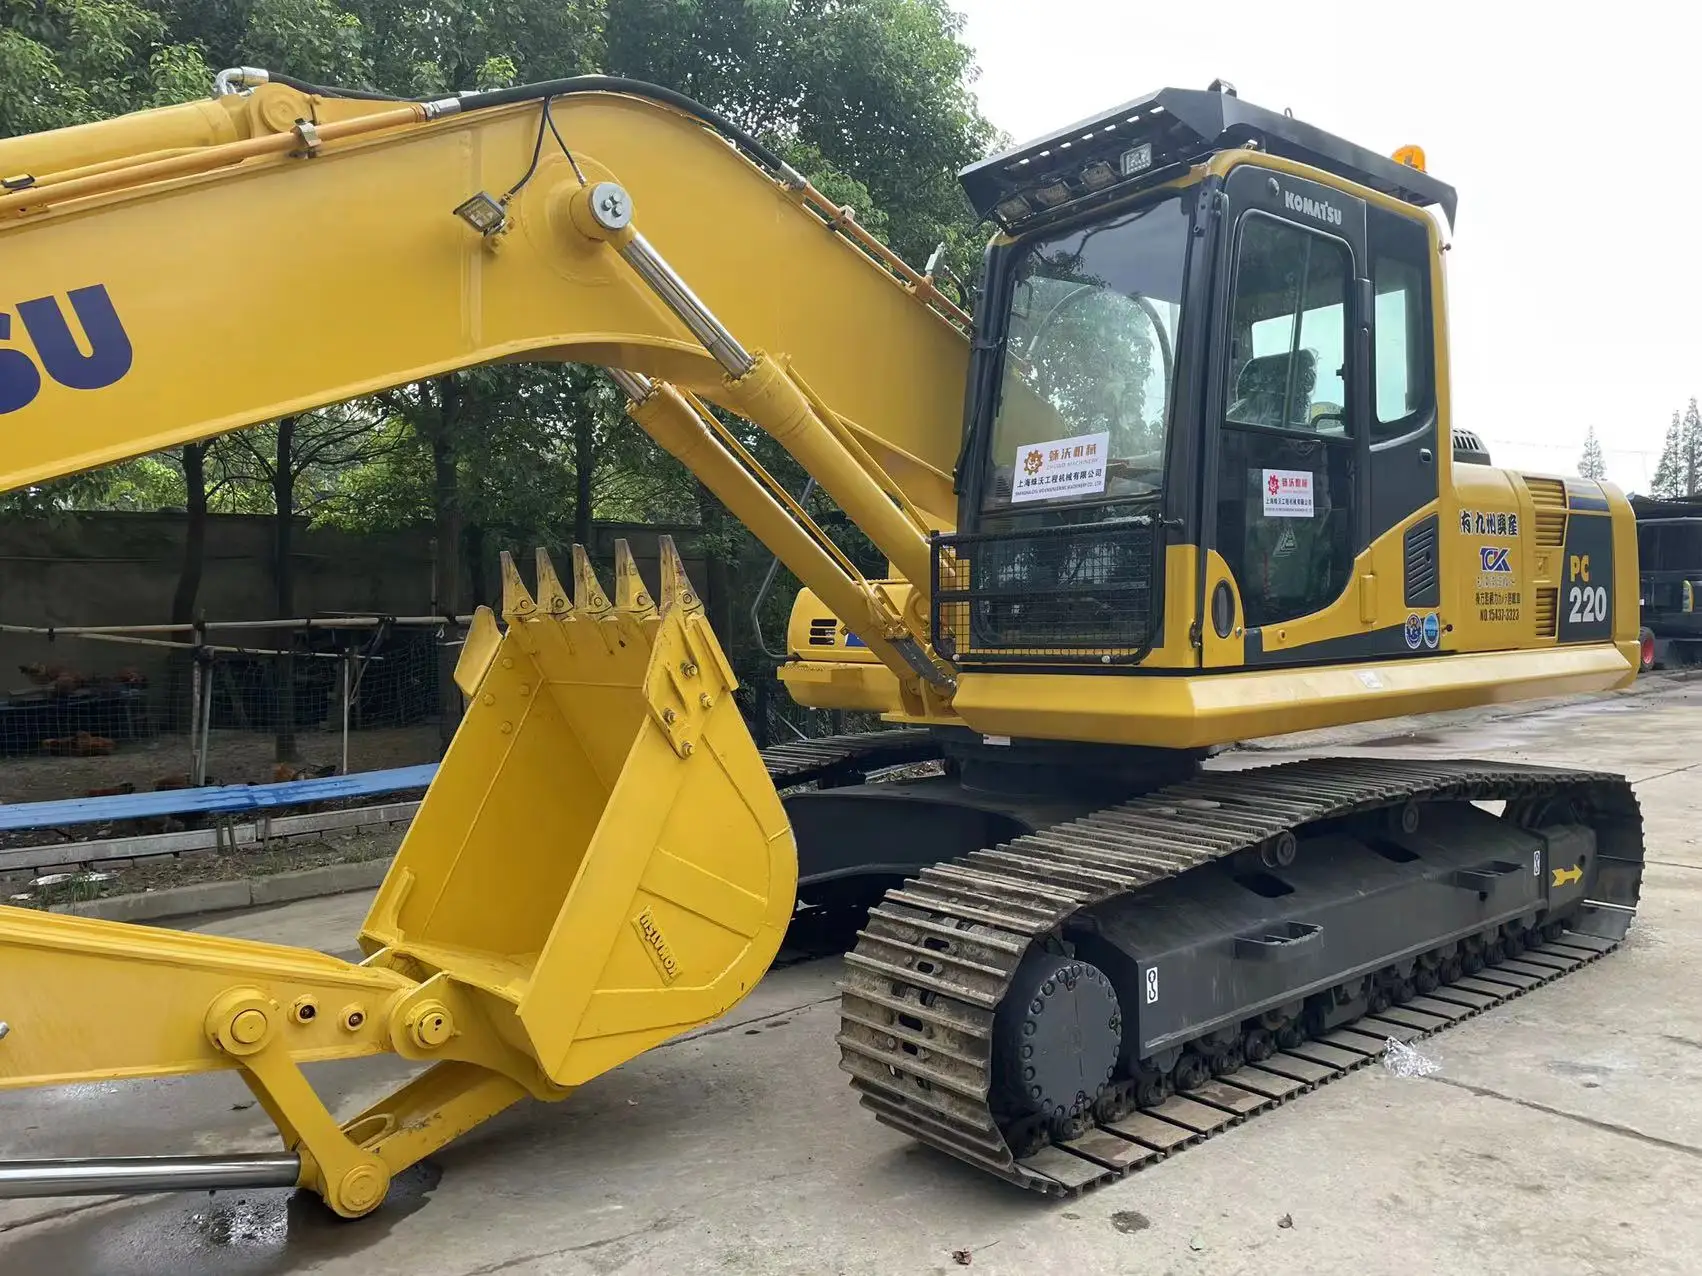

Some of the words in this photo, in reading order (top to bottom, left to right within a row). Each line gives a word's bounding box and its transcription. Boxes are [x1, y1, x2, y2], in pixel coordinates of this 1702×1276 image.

[1284, 190, 1342, 225] KOMATSU
[1570, 555, 1589, 582] PC
[1569, 586, 1607, 623] 220
